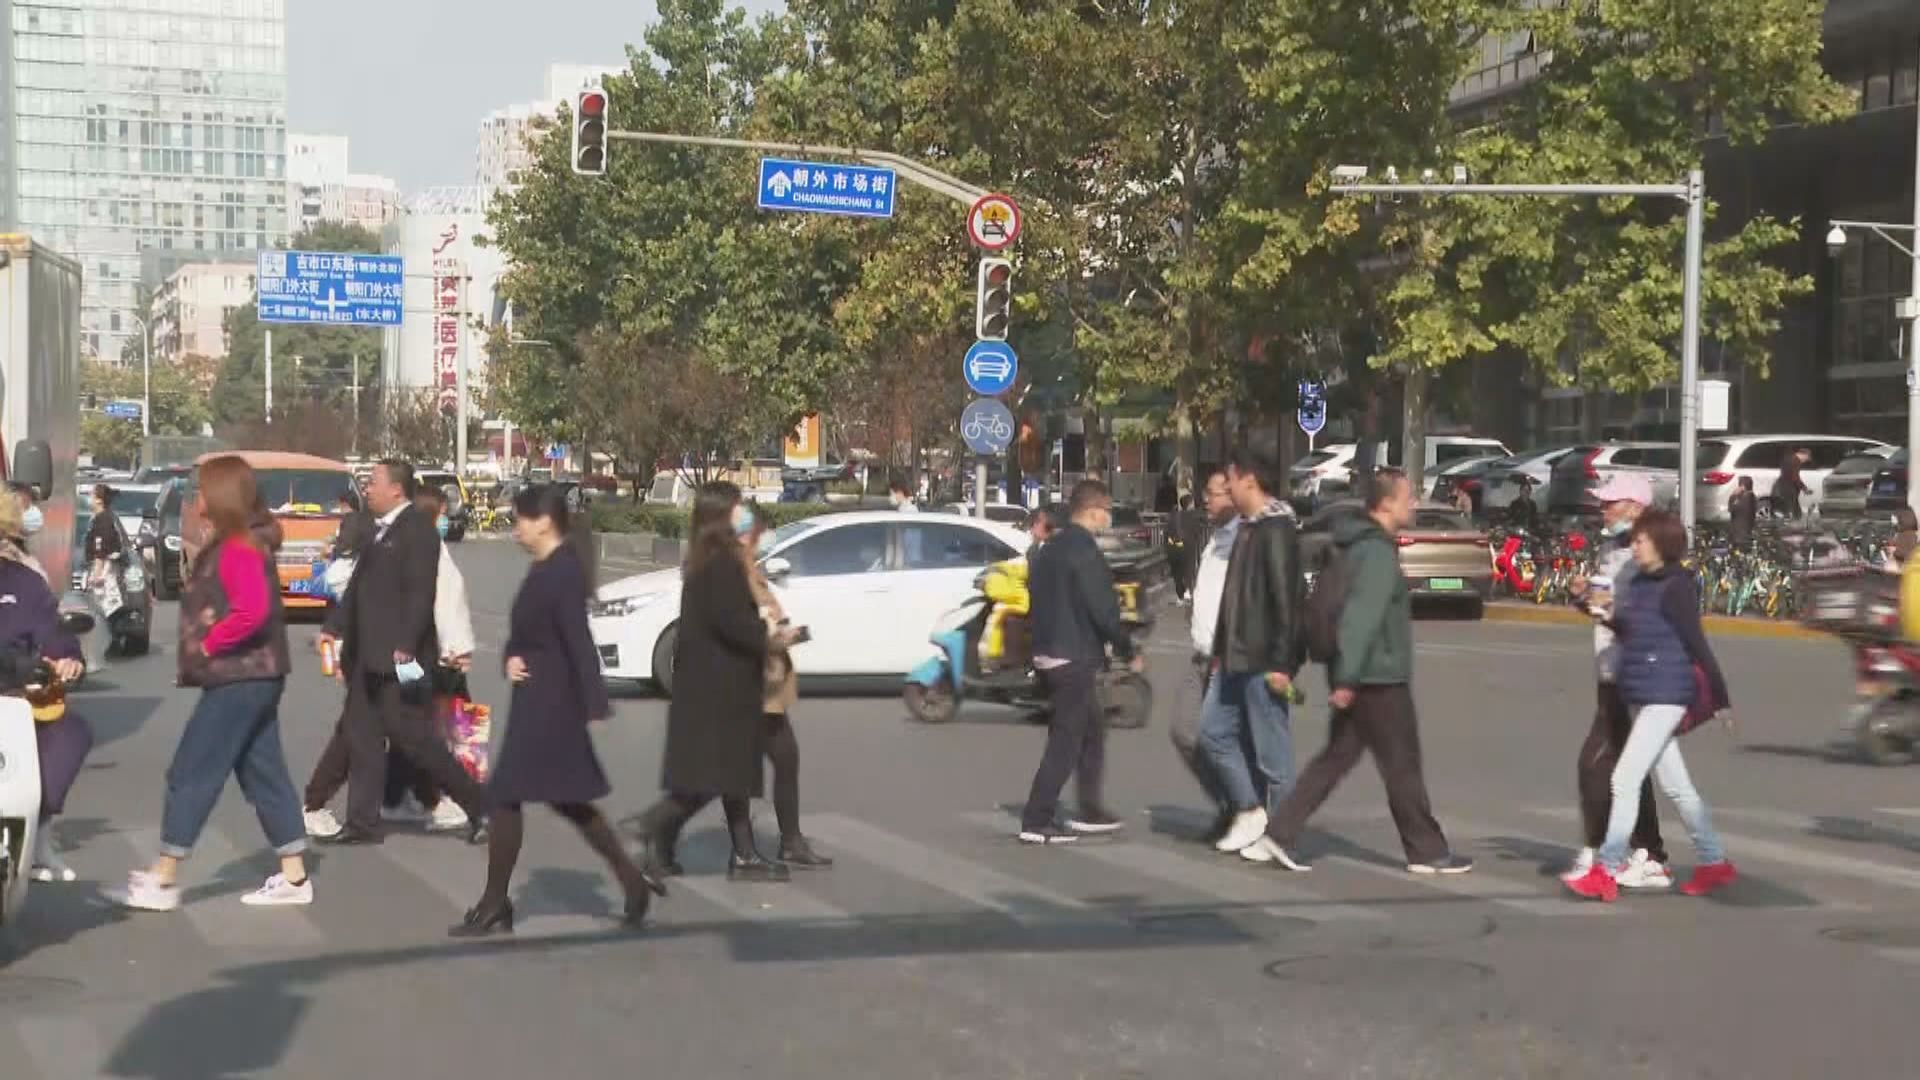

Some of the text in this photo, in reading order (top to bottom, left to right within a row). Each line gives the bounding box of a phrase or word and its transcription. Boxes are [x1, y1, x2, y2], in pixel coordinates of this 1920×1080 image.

[793, 168, 888, 195] 朝外市场街
[793, 193, 872, 209] CHAOWAISHICHANG
[296, 254, 354, 271] 吉市口东路
[261, 279, 320, 295] 朝阳门外大街
[345, 282, 402, 297] 朝阳门外大街
